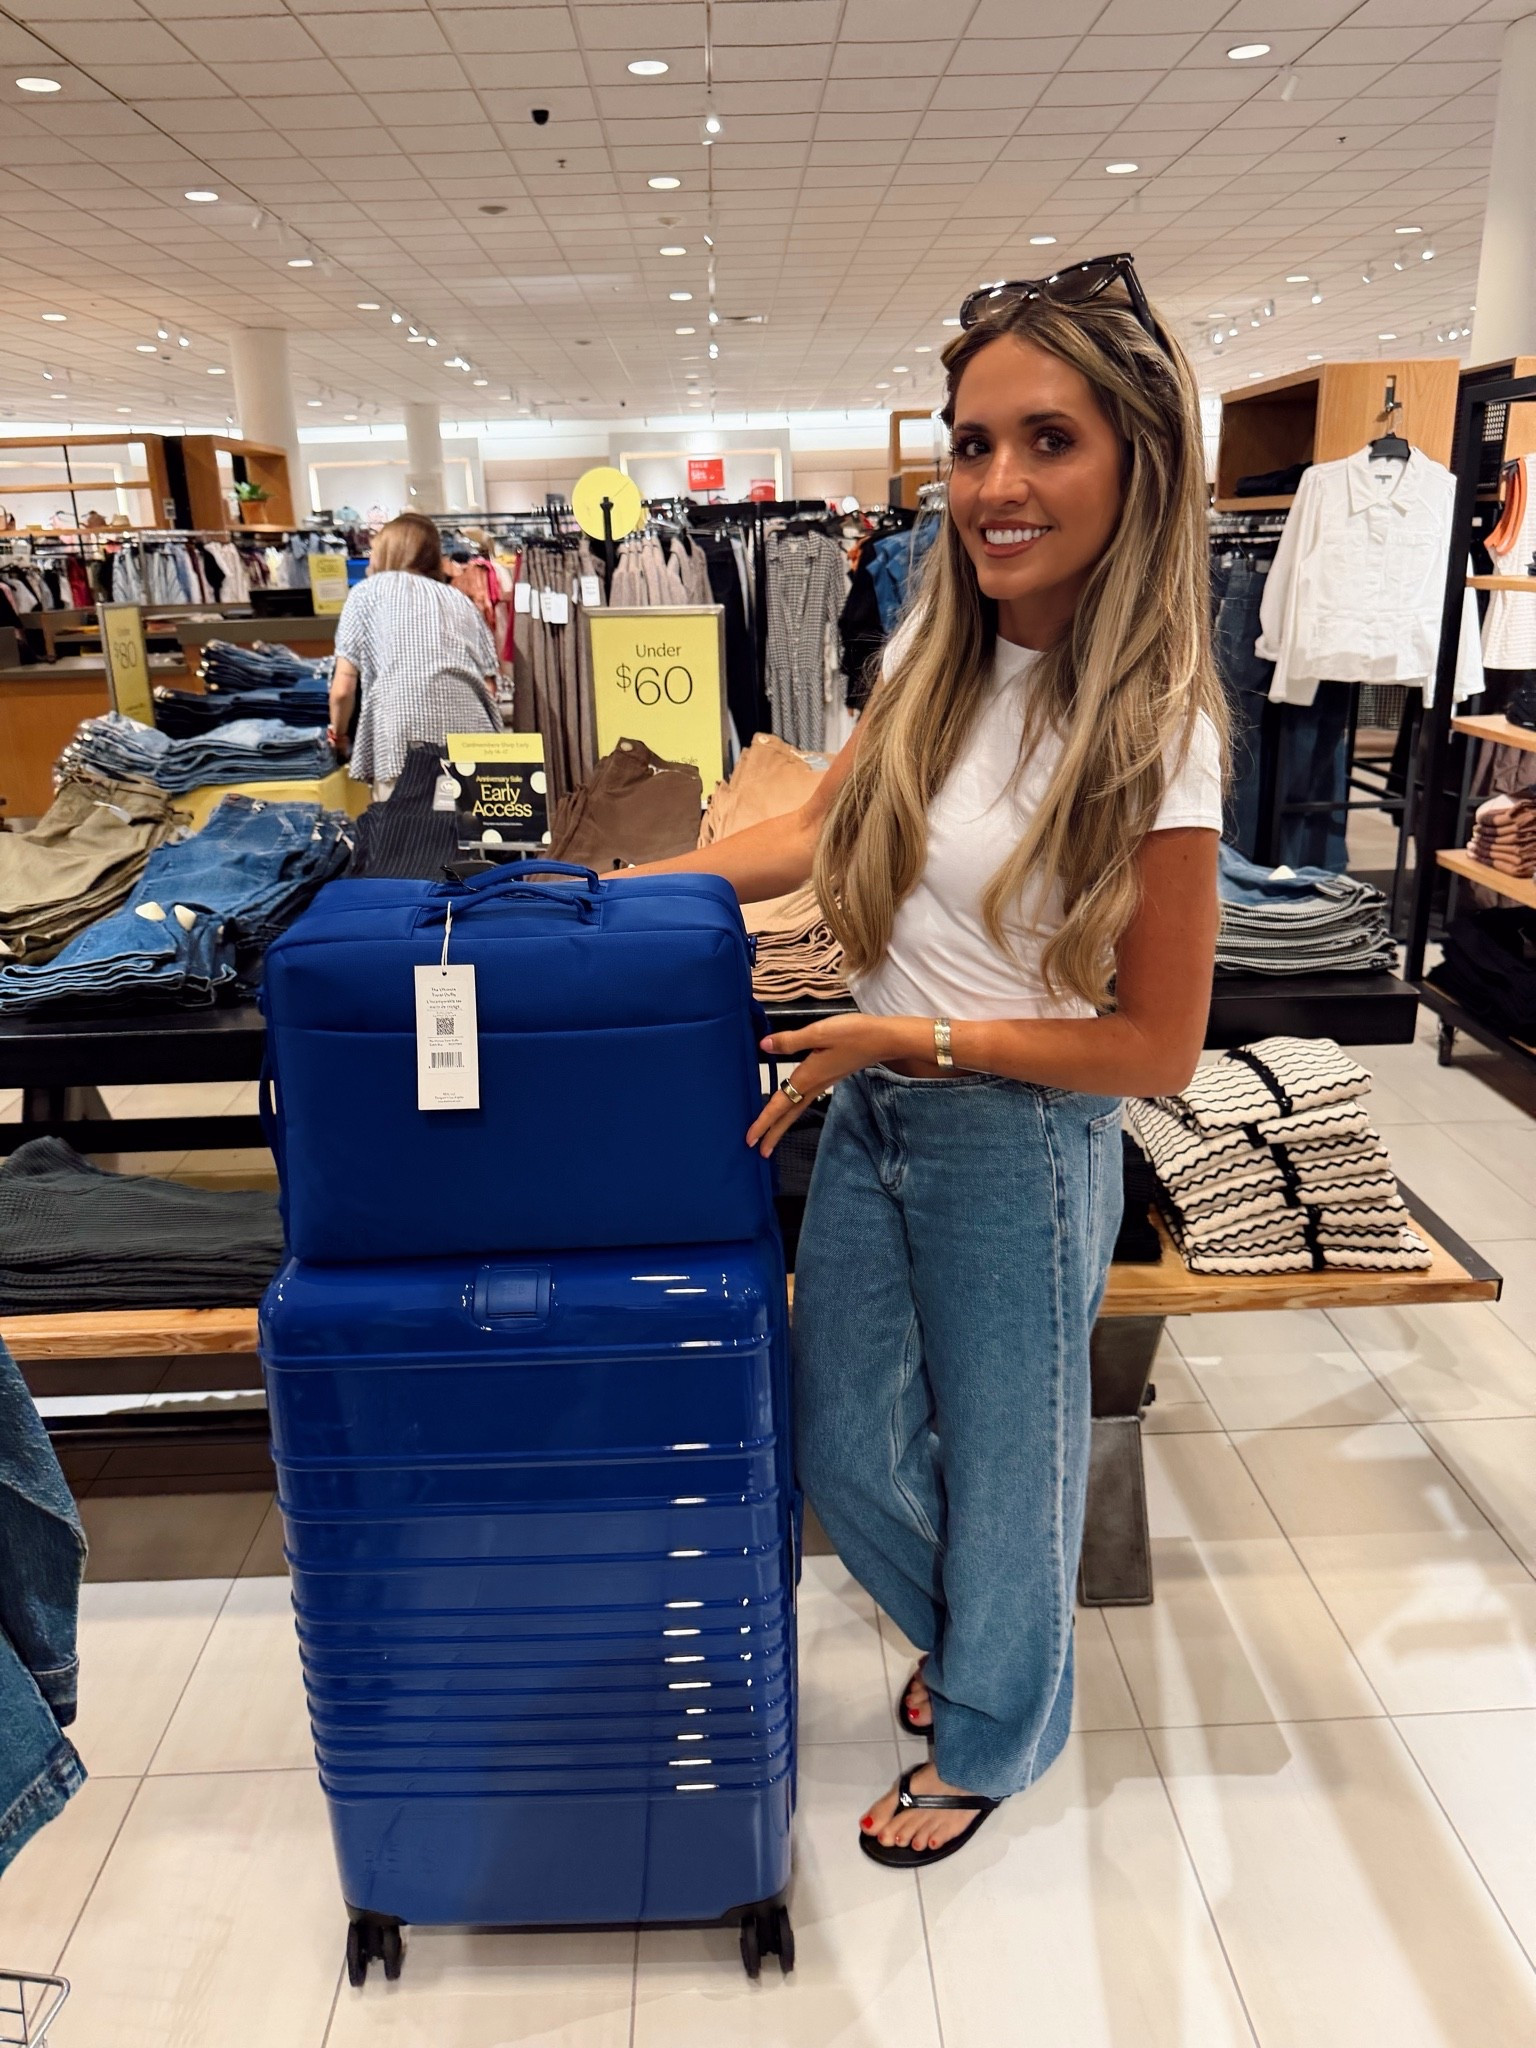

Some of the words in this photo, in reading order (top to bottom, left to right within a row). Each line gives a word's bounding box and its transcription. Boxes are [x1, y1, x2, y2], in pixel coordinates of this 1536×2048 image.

[113, 640, 138, 670] $80
[635, 643, 682, 658] Under
[615, 663, 693, 706] $60
[480, 783, 521, 805] Early
[471, 799, 533, 818] Access
